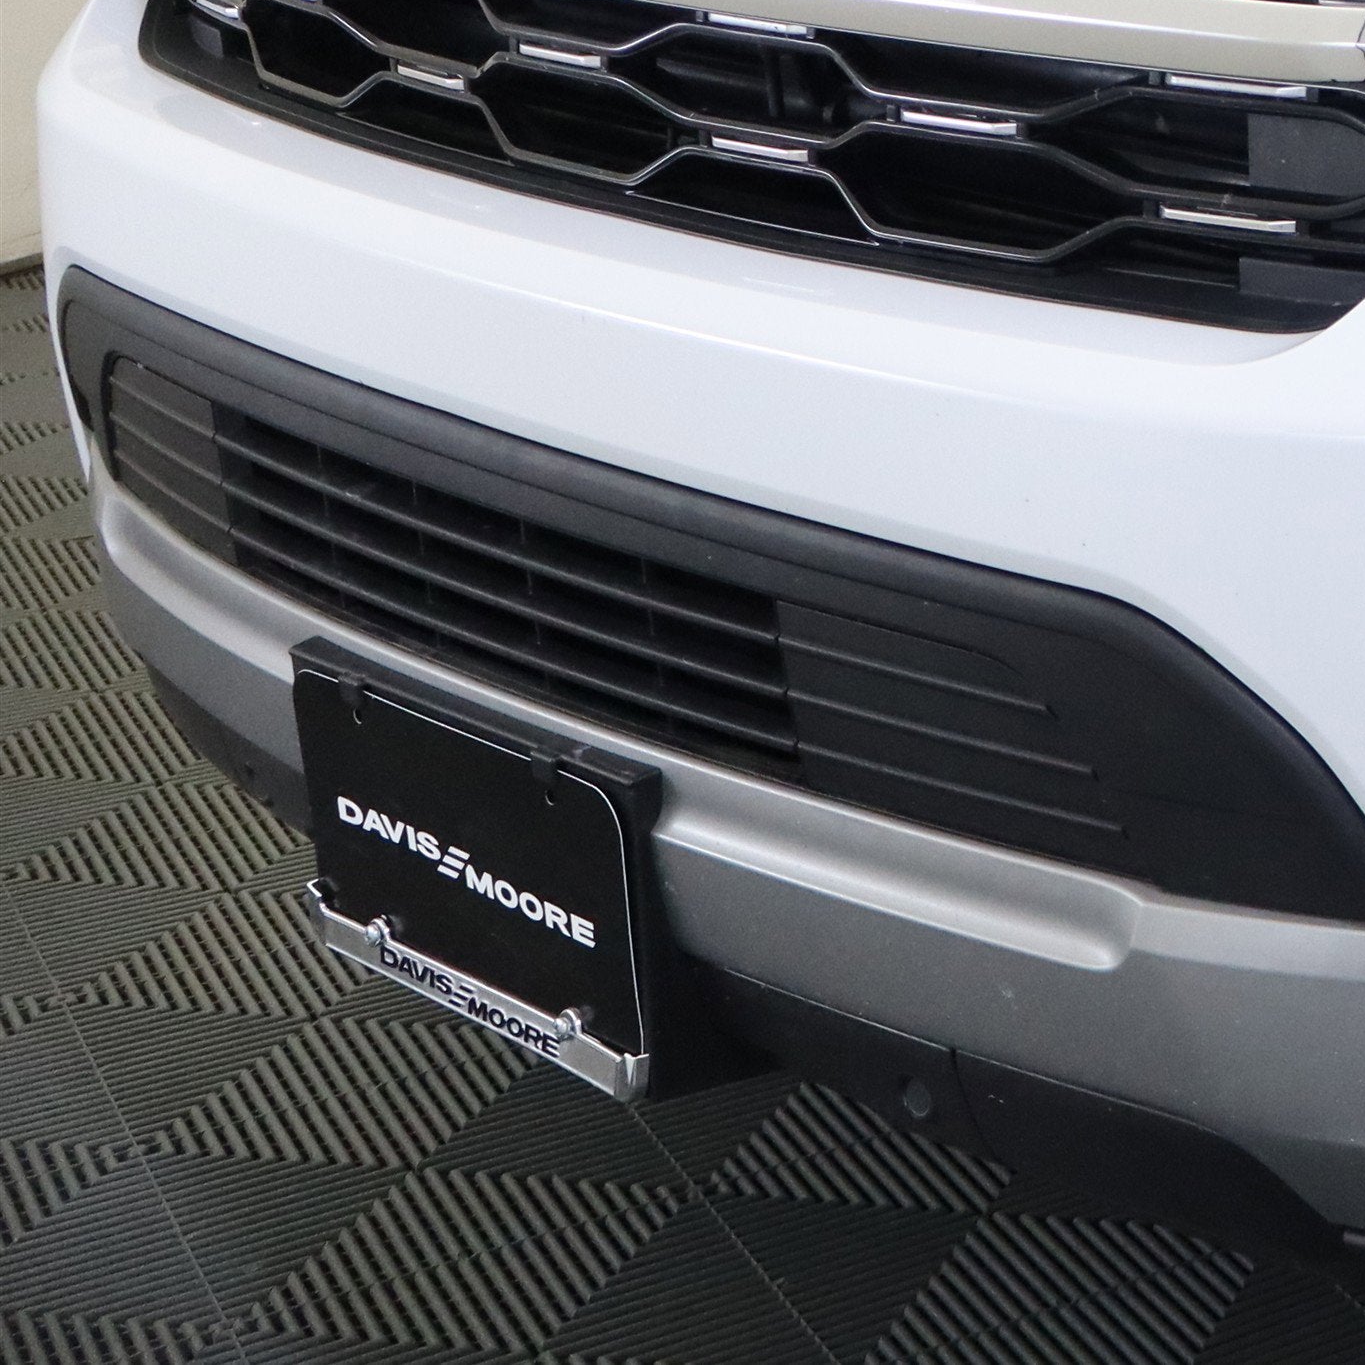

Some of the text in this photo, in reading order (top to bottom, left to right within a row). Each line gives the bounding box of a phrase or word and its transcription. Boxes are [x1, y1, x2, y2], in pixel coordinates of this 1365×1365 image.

[337, 795, 597, 949] DAVIS MOORE
[379, 944, 562, 1059] DAVIS MOORE
